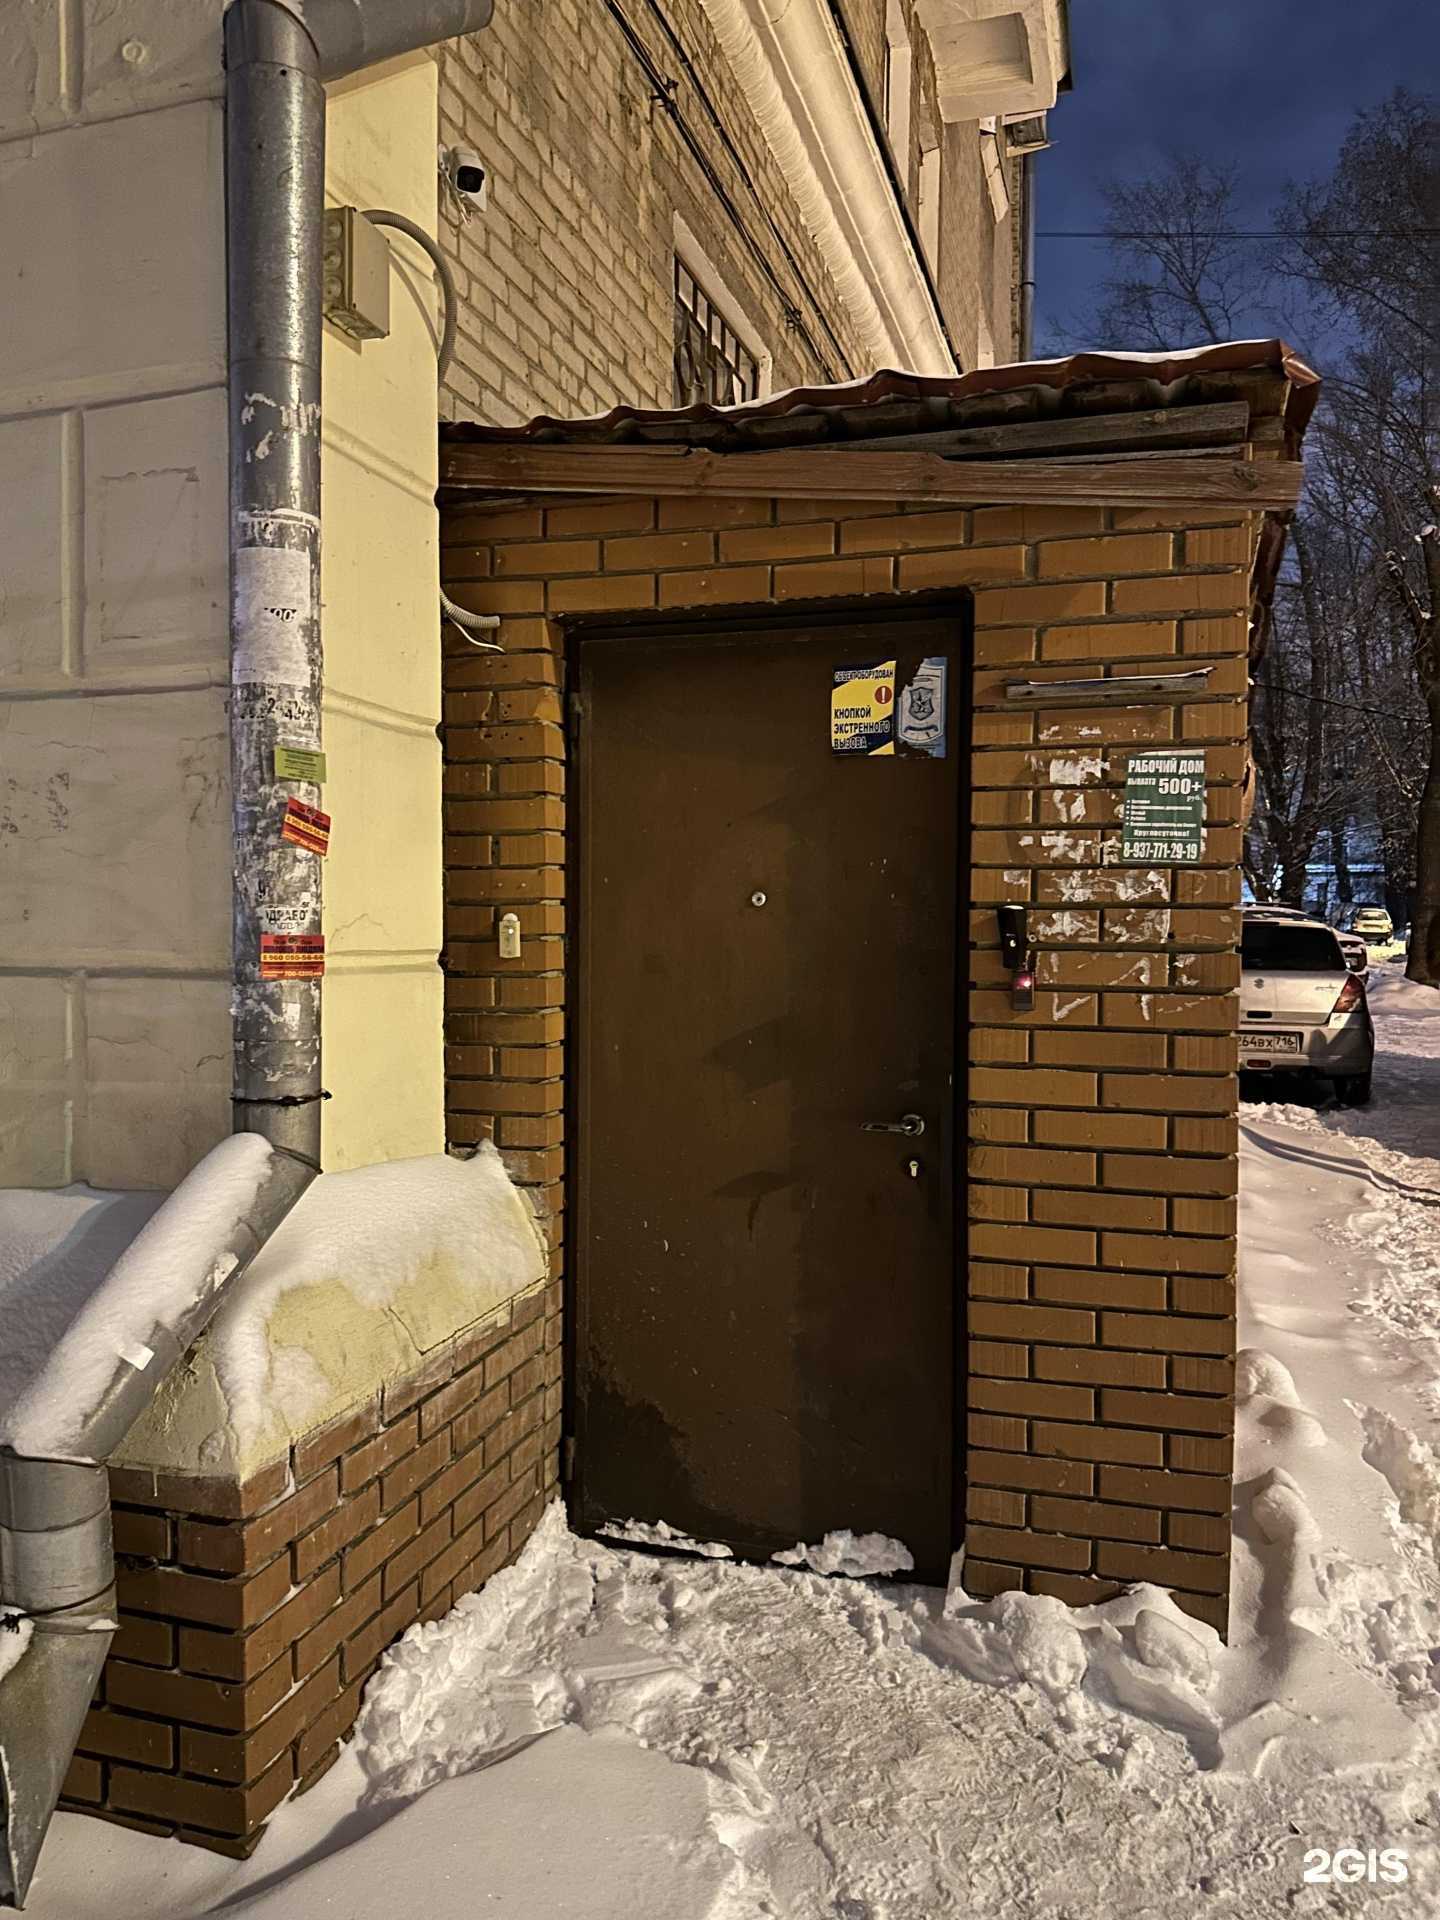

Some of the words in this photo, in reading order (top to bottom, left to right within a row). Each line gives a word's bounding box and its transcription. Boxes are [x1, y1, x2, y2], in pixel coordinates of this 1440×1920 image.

[834, 705, 871, 719] КНОПКОЙ
[834, 721, 890, 733] ЭКСТРЕННОГО
[834, 737, 867, 748] ВЫЗОВА
[1128, 758, 1177, 773] РАБОЧИЙ
[1178, 760, 1204, 775] ДОМ
[1158, 778, 1202, 795] 500+
[1123, 842, 1198, 860] 8-937-771-29-19
